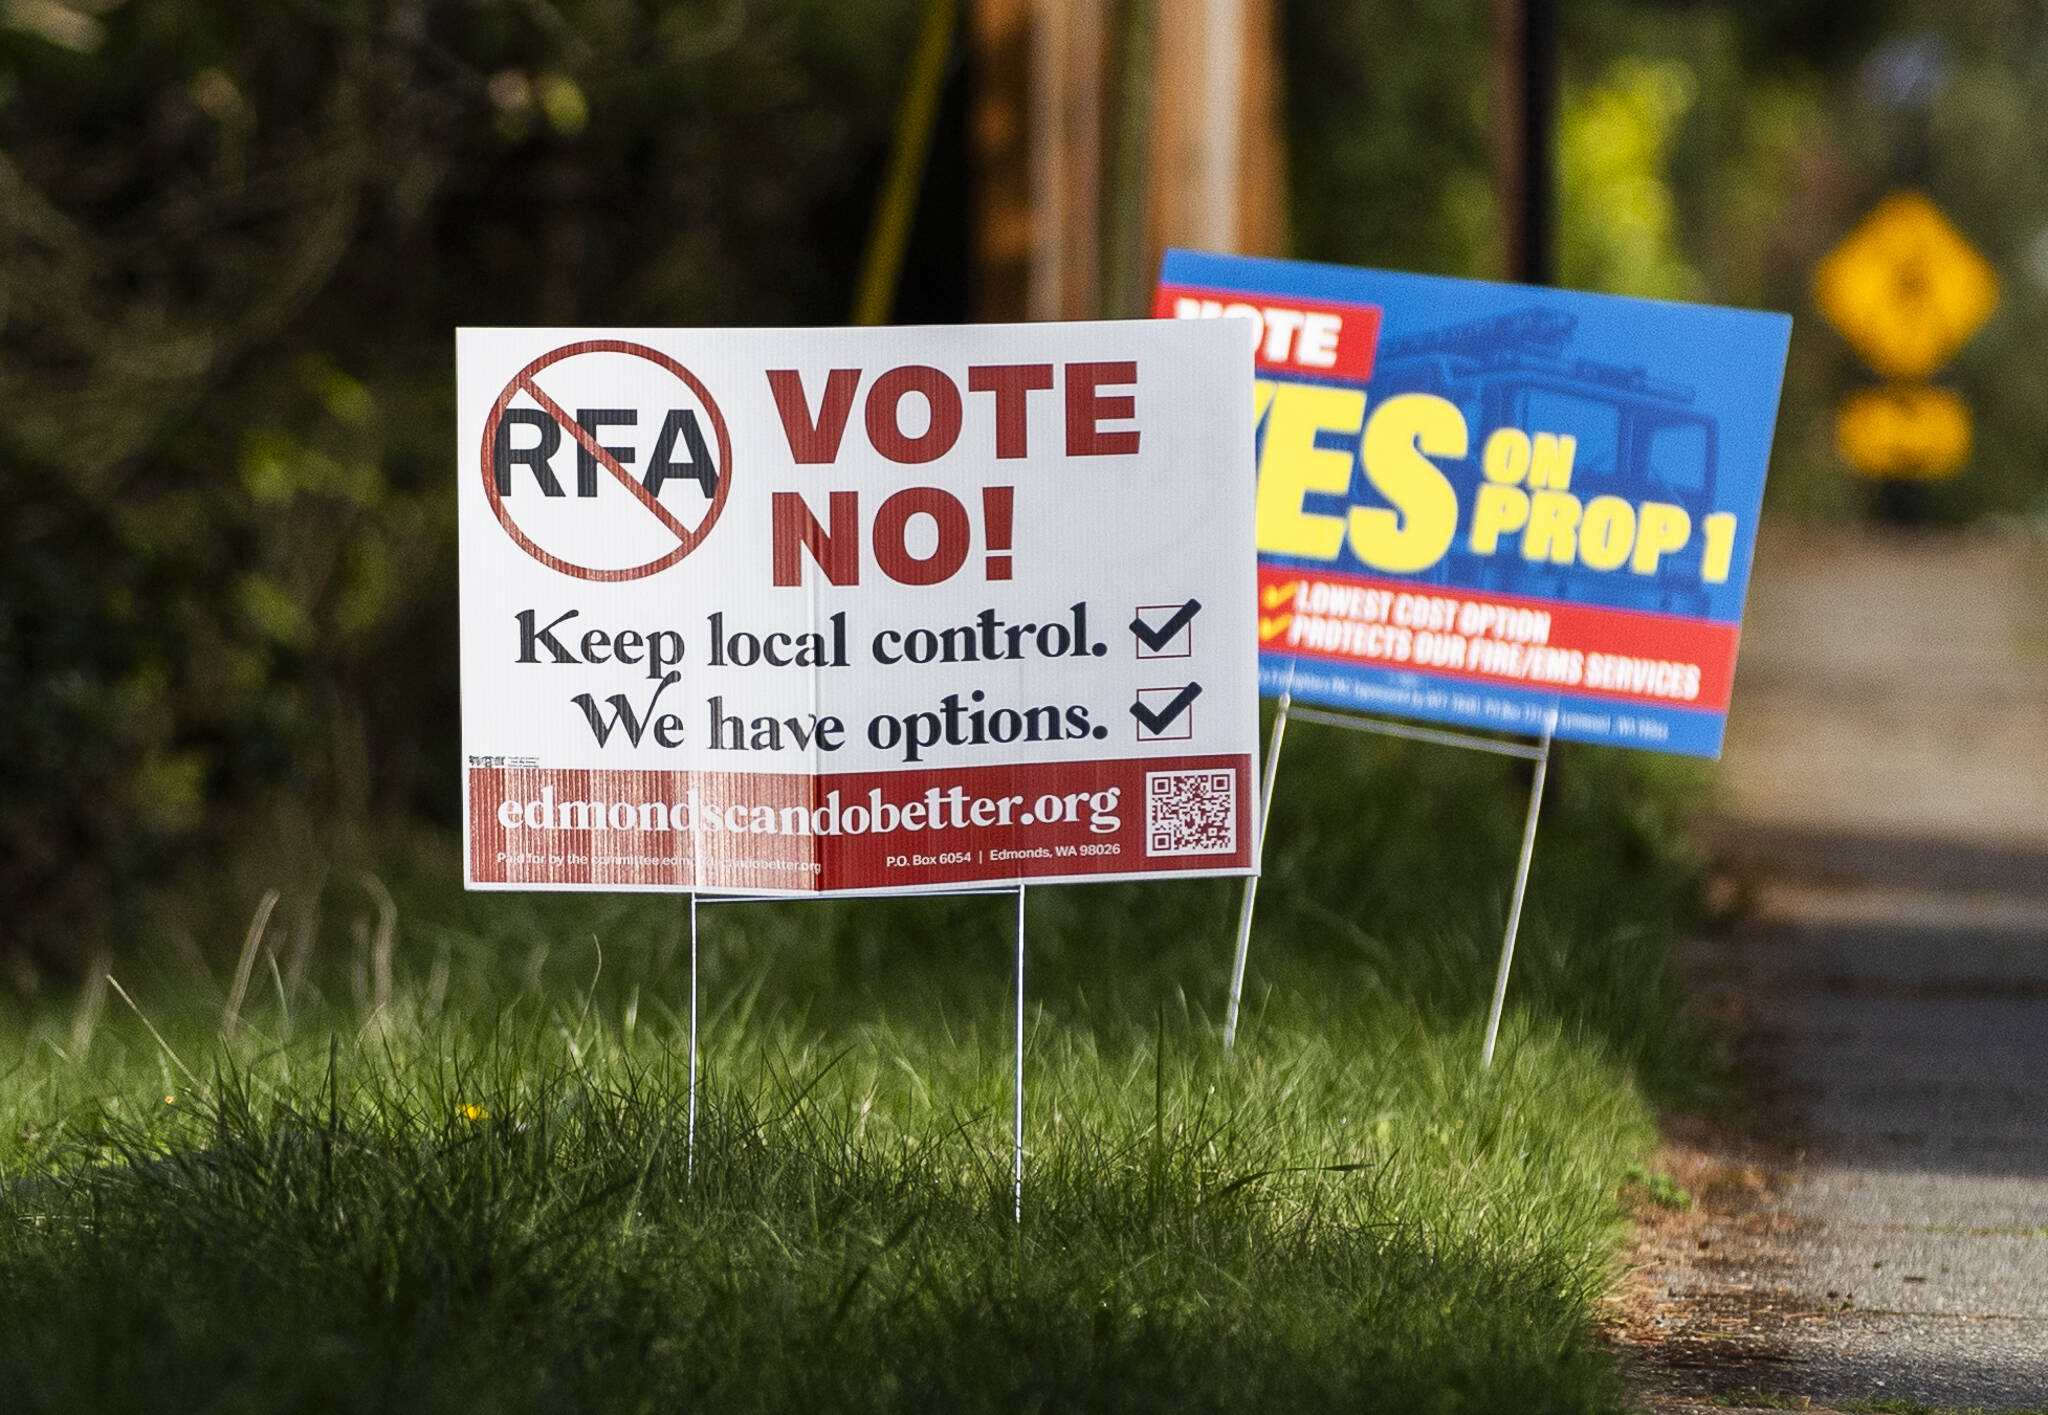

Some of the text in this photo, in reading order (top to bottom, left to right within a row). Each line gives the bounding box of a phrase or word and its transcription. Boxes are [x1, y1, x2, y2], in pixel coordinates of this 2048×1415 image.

[493, 408, 720, 499] RFA
[766, 361, 1141, 464] VOTE
[1482, 427, 1577, 491] ON
[772, 486, 1015, 587] NO!
[1469, 482, 1738, 584] PROP 1
[514, 602, 1108, 679] Keep local control.
[1294, 580, 1551, 645] LOWEST COST OPTION
[1287, 613, 1701, 701] PROTECTS OUR FIRE/EMS SERVICES
[570, 670, 1109, 762] We have options.
[497, 785, 1122, 836] edmondscandobetter.org
[526, 853, 545, 865] for
[549, 853, 564, 867] by
[567, 854, 588, 865] the
[591, 854, 659, 867] committee
[886, 843, 1121, 867] P.O. Box 6054 Edmonds, WA 98026
